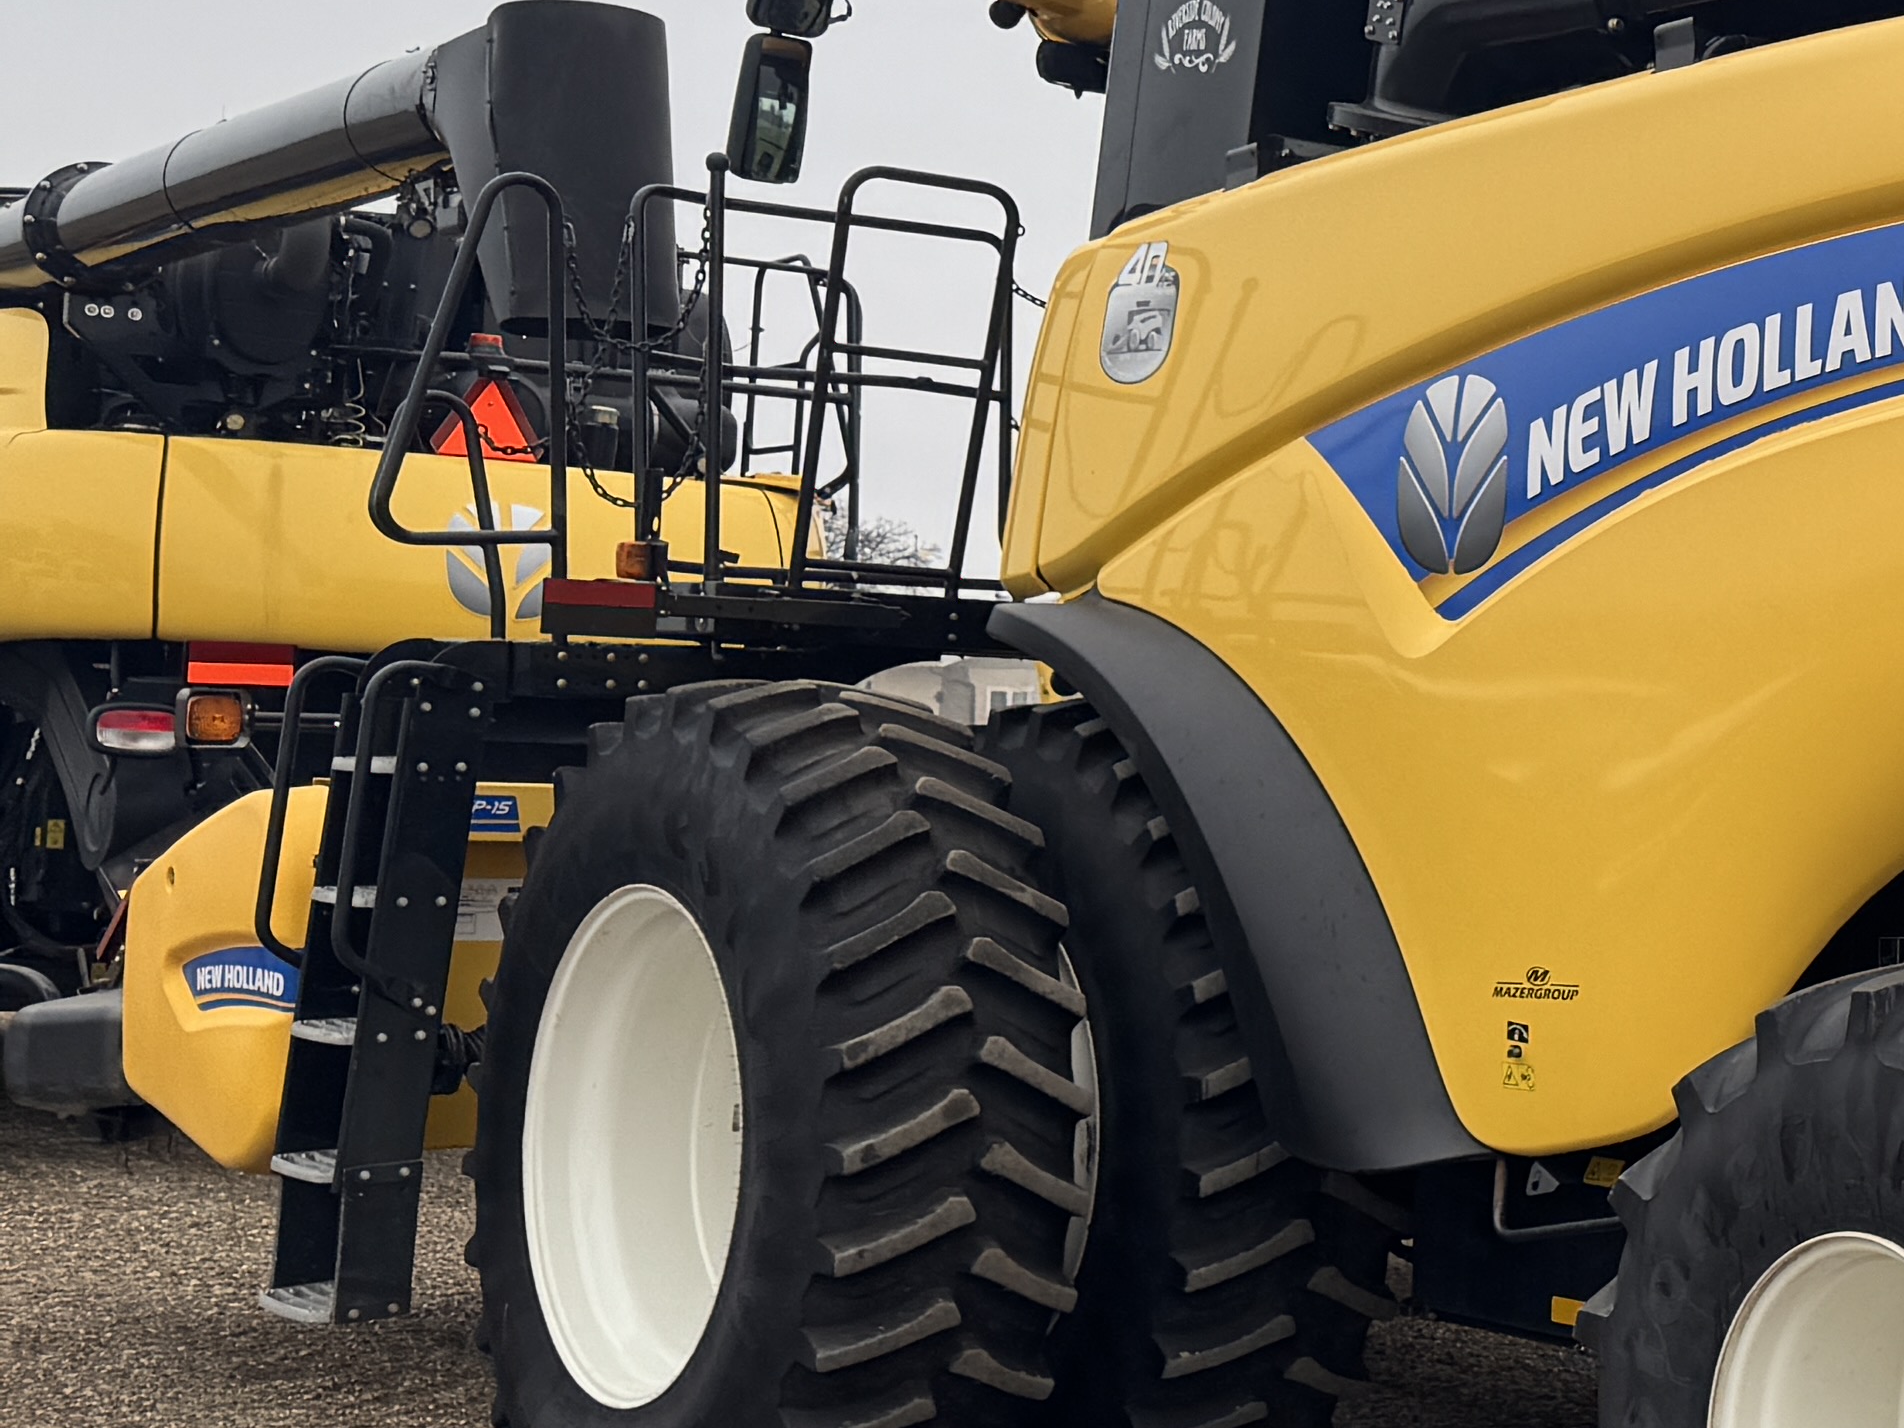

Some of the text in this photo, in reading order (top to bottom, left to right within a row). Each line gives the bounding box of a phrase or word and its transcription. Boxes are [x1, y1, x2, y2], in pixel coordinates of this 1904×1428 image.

[1183, 28, 1206, 51] FARMS
[1526, 358, 1659, 500] NEW
[196, 964, 285, 997] NEW HOLLAND
[1492, 986, 1580, 1001] MAZERGROUP
